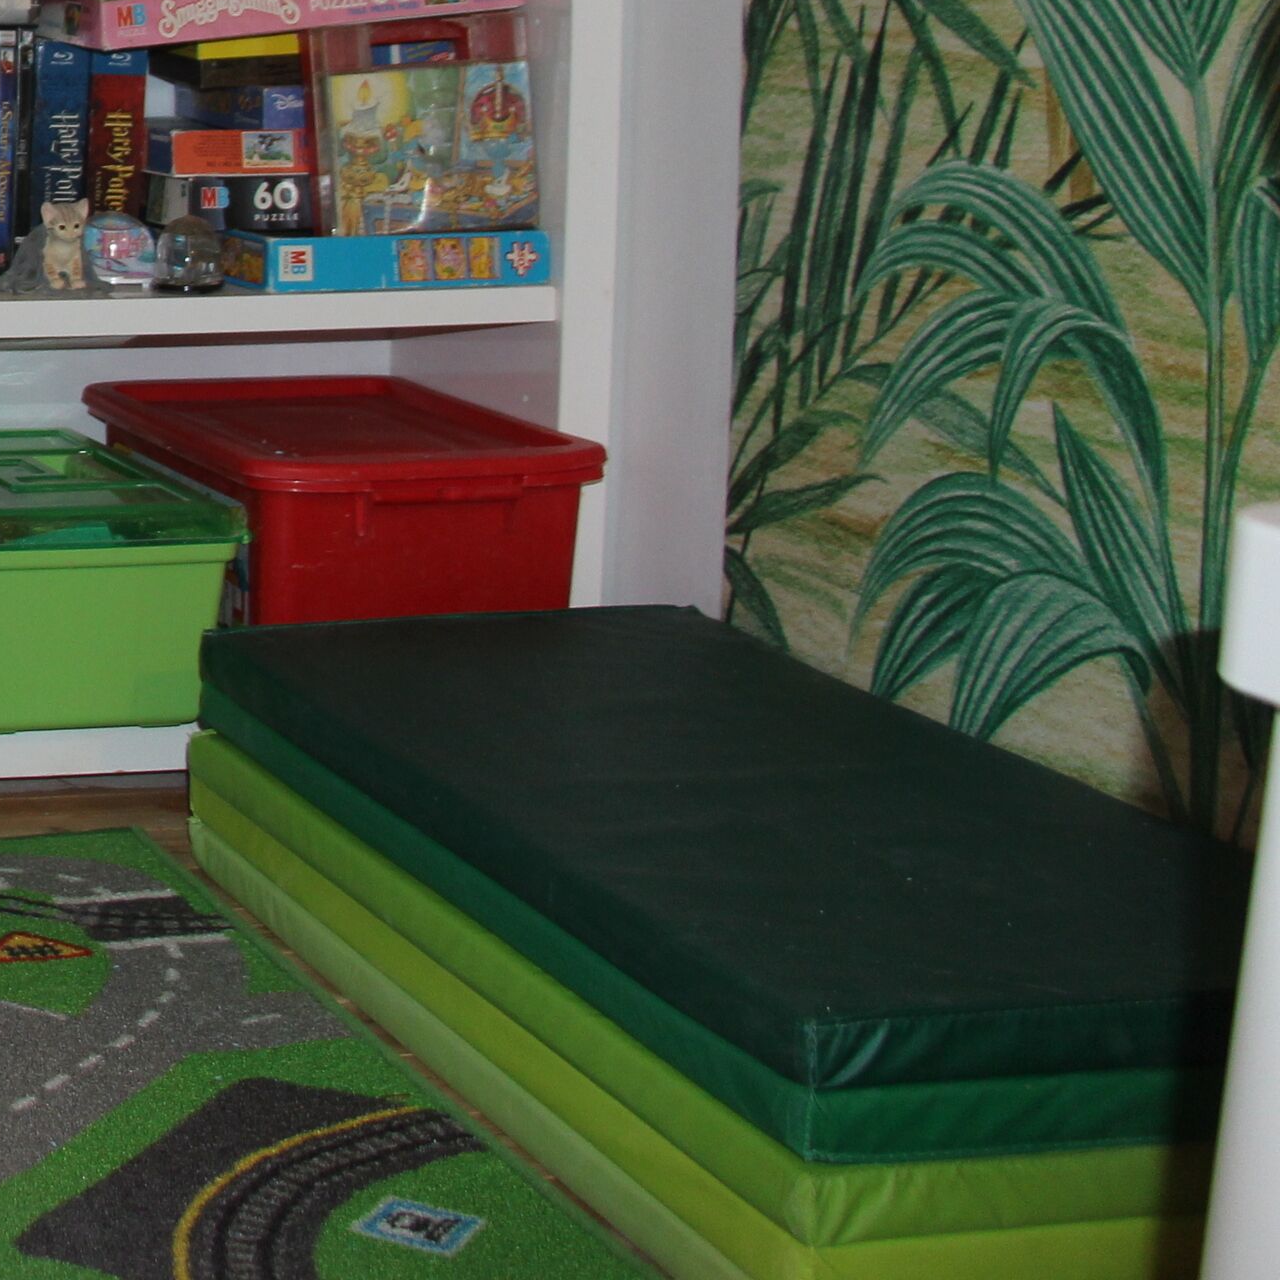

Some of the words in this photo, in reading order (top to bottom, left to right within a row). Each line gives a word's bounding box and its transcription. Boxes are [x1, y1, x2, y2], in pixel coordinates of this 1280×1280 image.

[117, 4, 145, 27] MB
[201, 186, 229, 209] MB
[253, 181, 299, 210] 60
[254, 213, 299, 221] PUZZLE
[291, 251, 307, 274] MB
